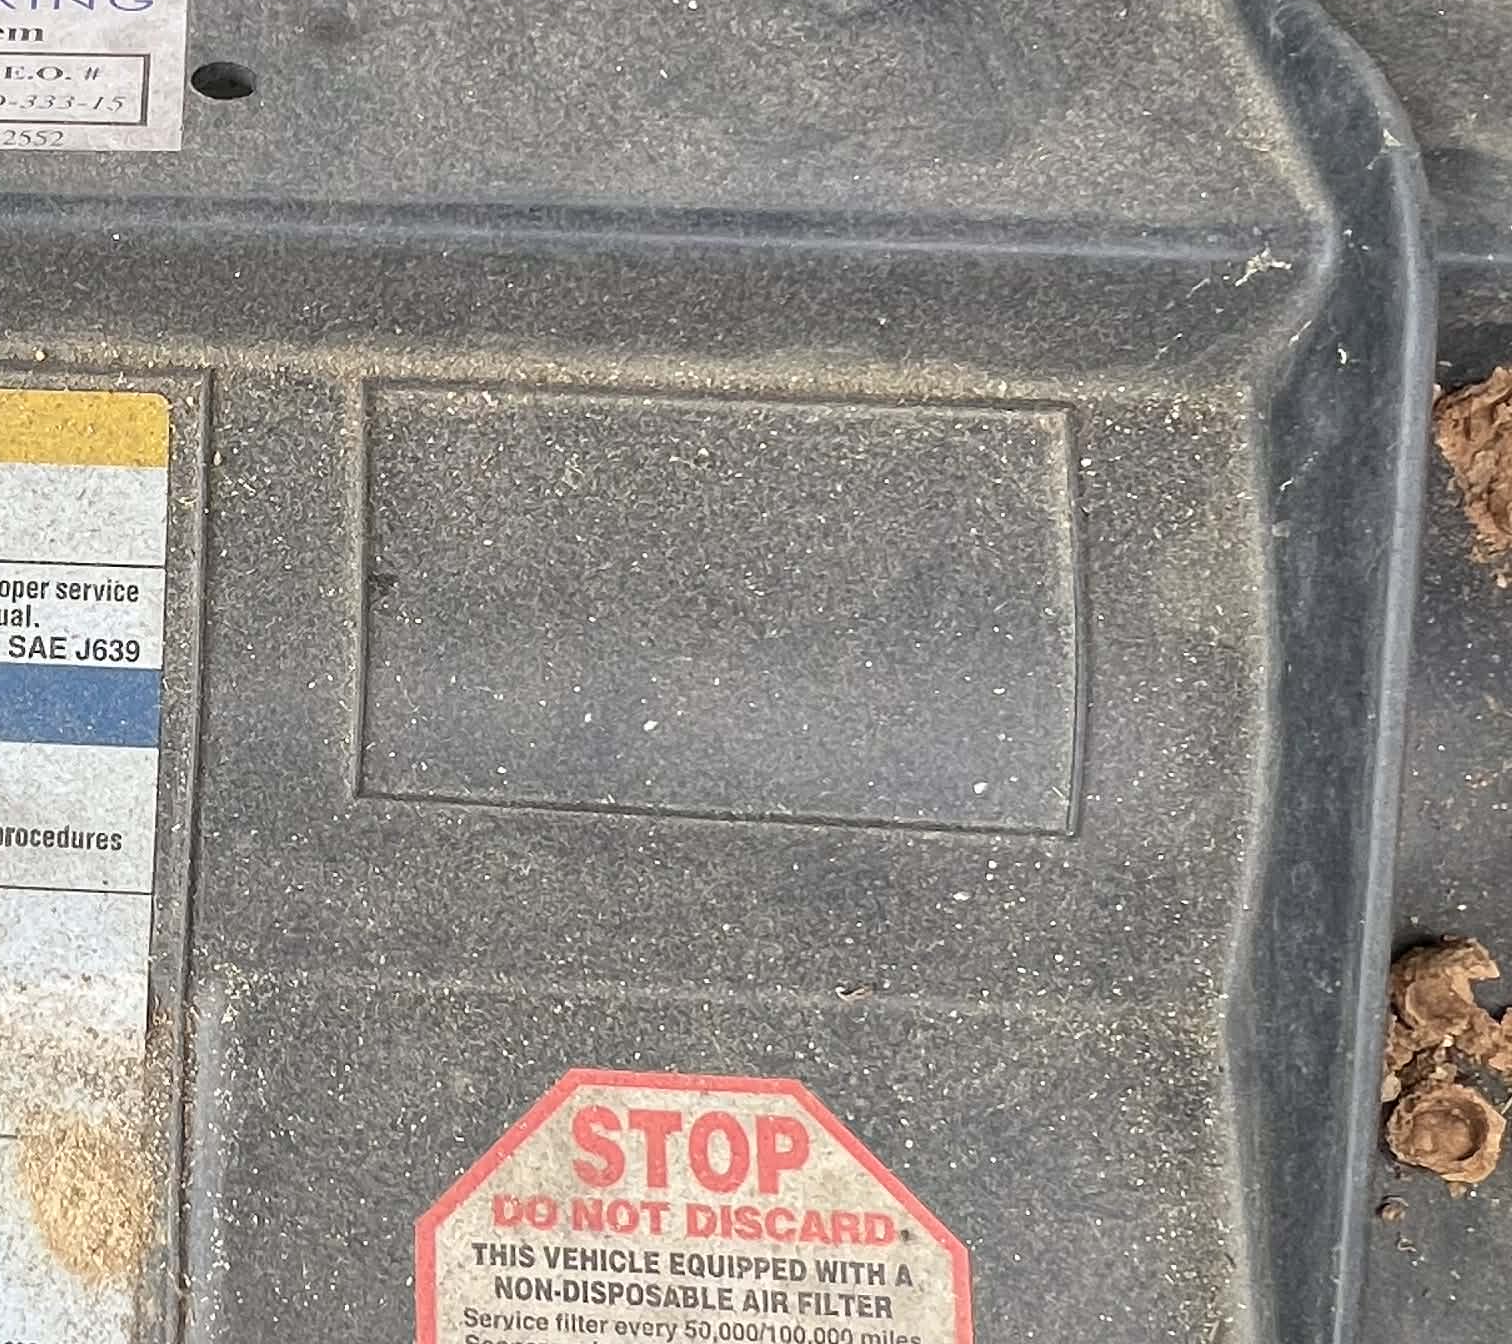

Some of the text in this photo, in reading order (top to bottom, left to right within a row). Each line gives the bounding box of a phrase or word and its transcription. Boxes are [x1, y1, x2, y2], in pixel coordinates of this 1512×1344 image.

[4, 65, 72, 81] E.O.
[55, 578, 140, 603] service
[7, 634, 67, 660] SAE
[74, 638, 141, 663] J639
[571, 1106, 810, 1195] STOP
[493, 1193, 897, 1246] DO NOT DISCARD
[471, 1242, 913, 1287] THIS VEHICLE EQUIPPED WITH A
[494, 1275, 893, 1319] NON-DISPOSABLE AIR FILTER
[463, 1307, 550, 1331] Service
[555, 1312, 609, 1334] filter
[614, 1321, 678, 1344] every
